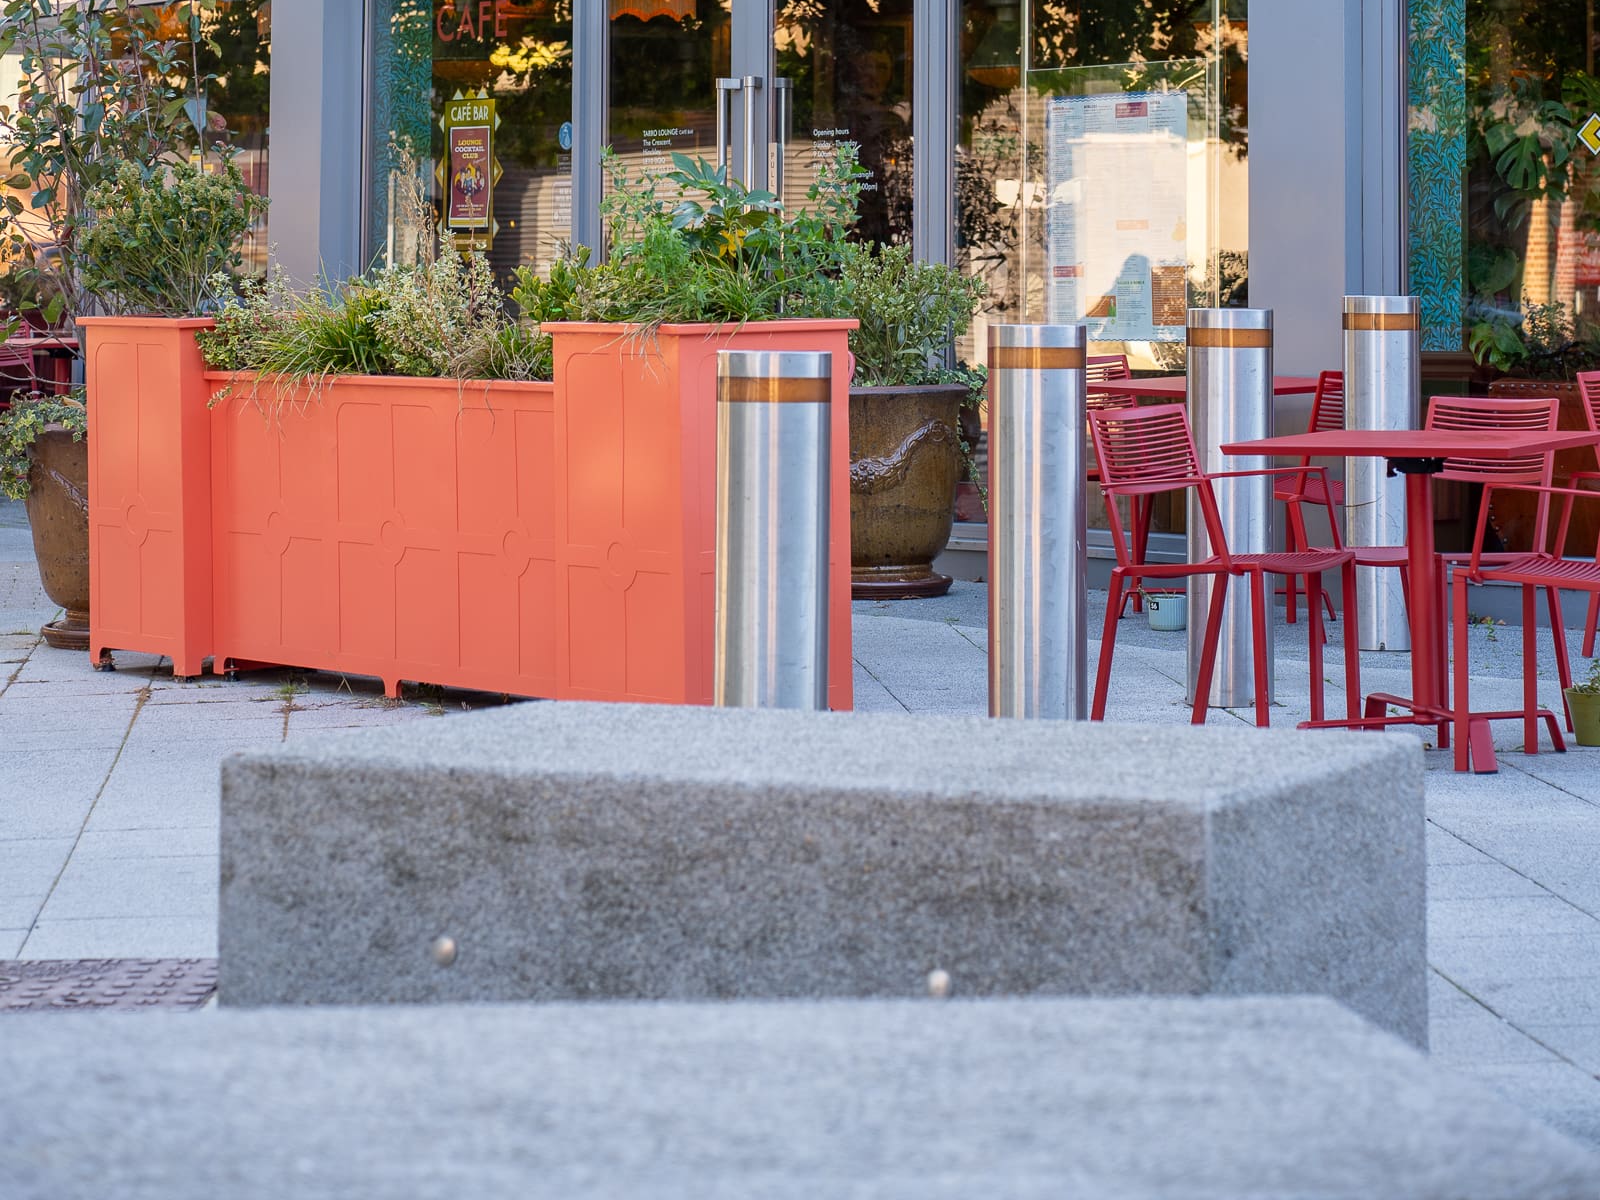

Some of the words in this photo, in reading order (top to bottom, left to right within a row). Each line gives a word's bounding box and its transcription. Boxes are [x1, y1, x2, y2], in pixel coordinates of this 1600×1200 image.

[451, 102, 471, 121] CAFÉ
[473, 105, 488, 120] BAR
[643, 129, 657, 137] TARRO
[658, 128, 679, 136] LOUNGE
[813, 128, 834, 137] Opening
[835, 127, 850, 135] hours
